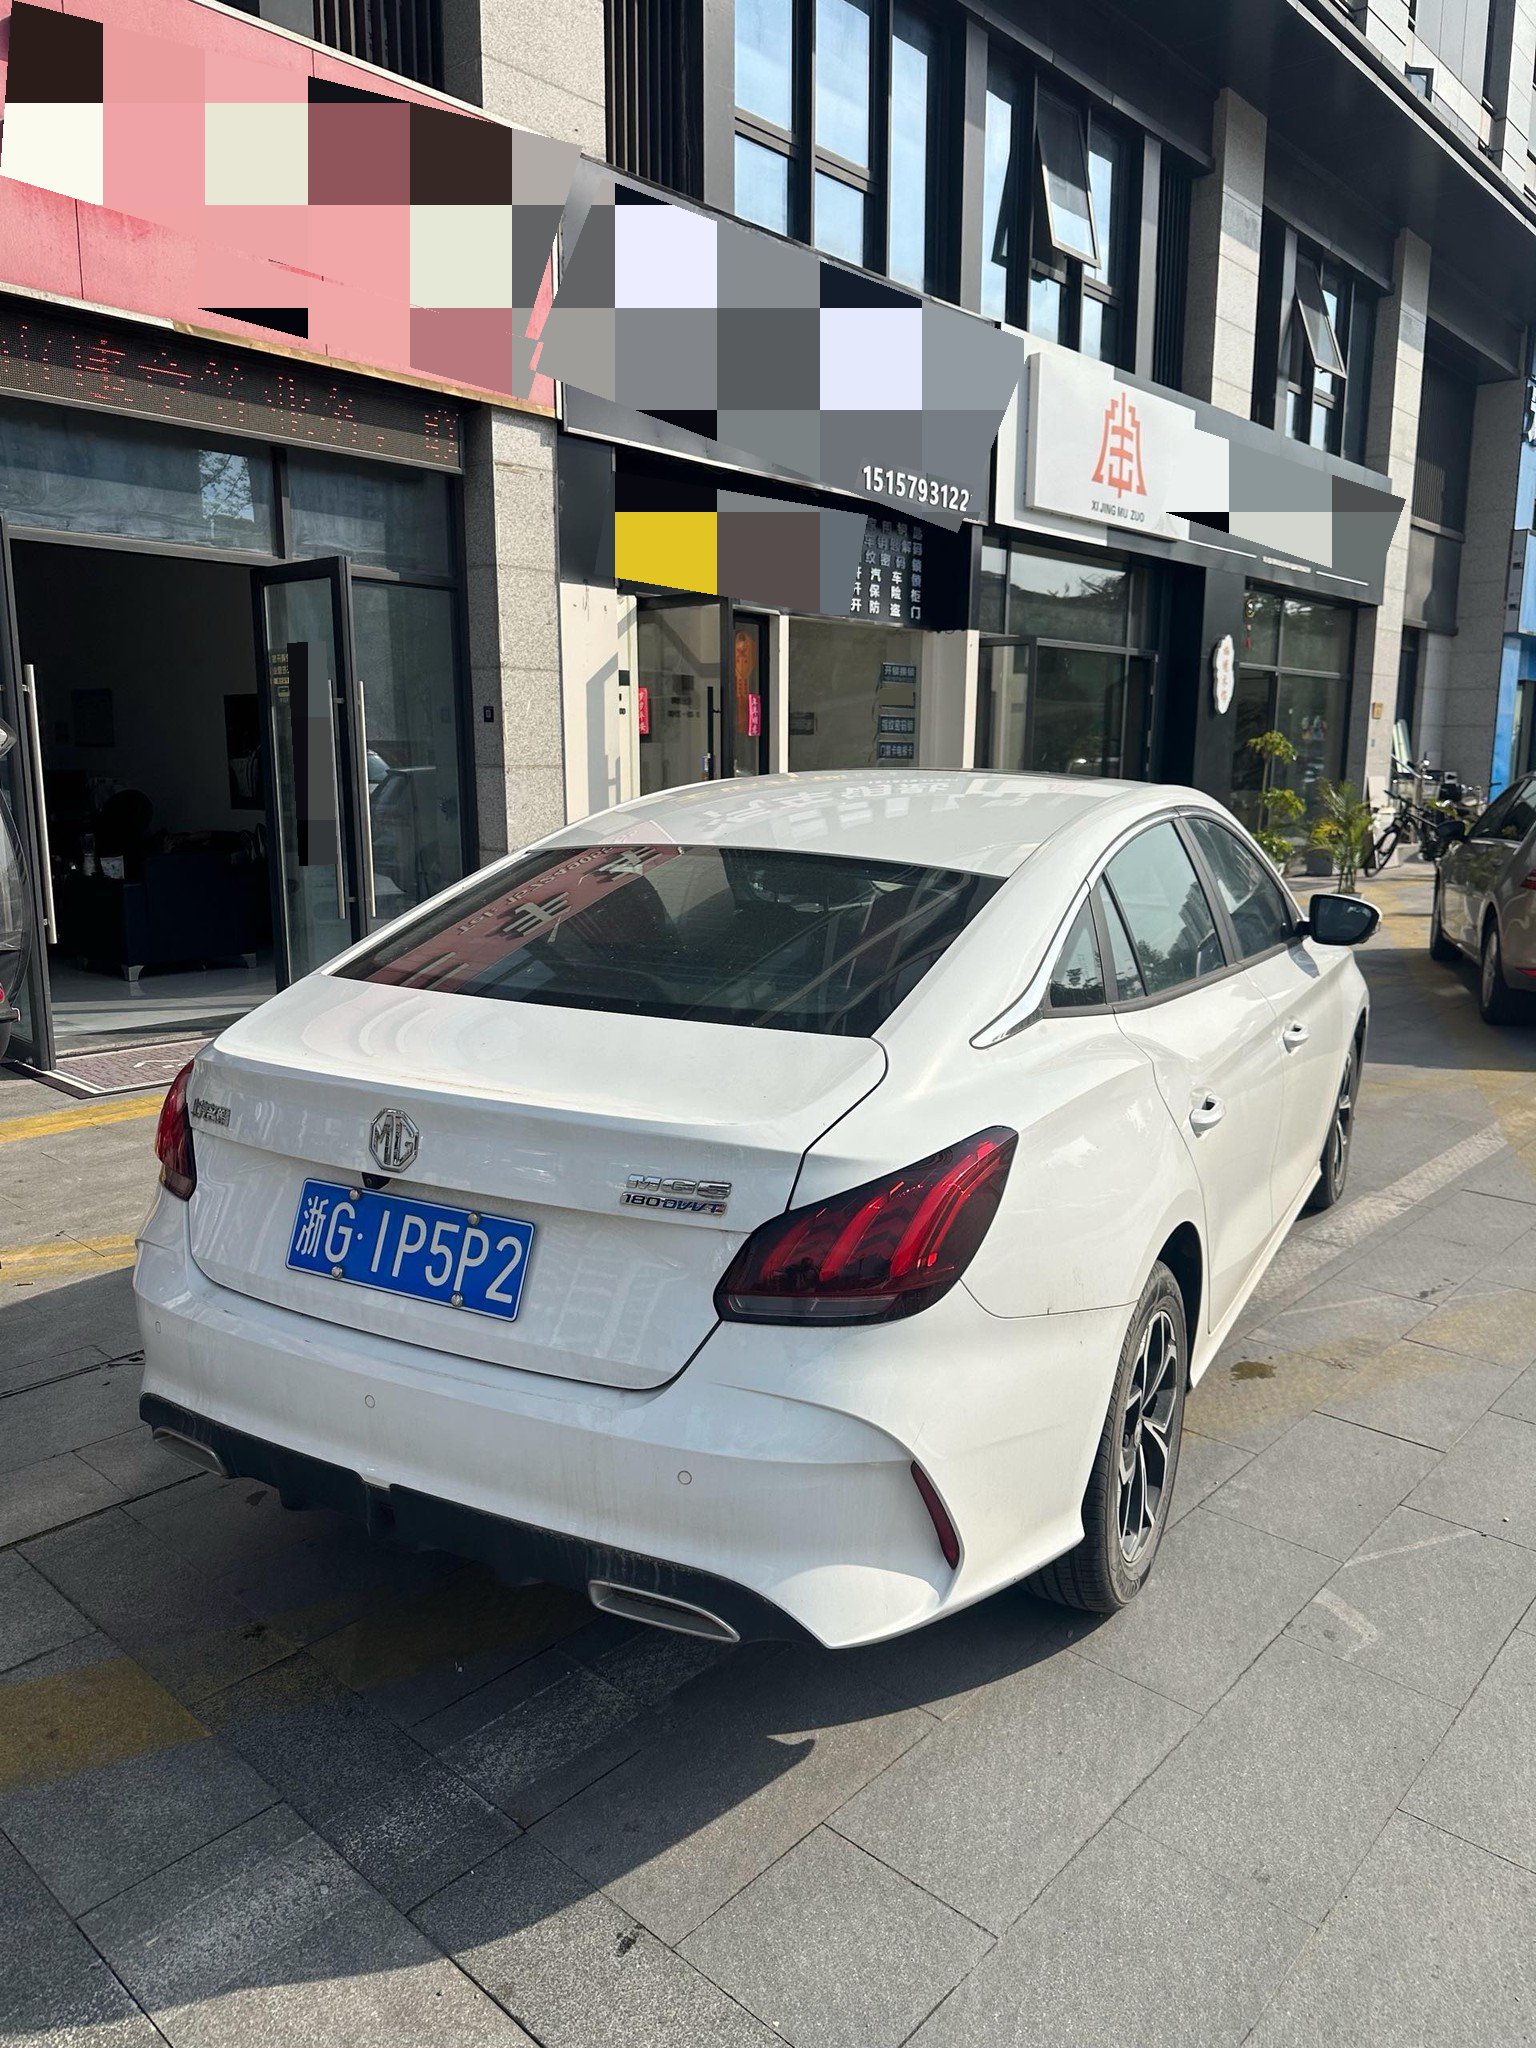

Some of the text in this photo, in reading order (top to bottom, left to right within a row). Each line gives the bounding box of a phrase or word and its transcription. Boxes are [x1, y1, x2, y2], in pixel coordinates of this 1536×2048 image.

[1091, 500, 1145, 523] XI JING MU ZUO
[851, 598, 920, 620] 开防盗门
[371, 1111, 416, 1169] MG
